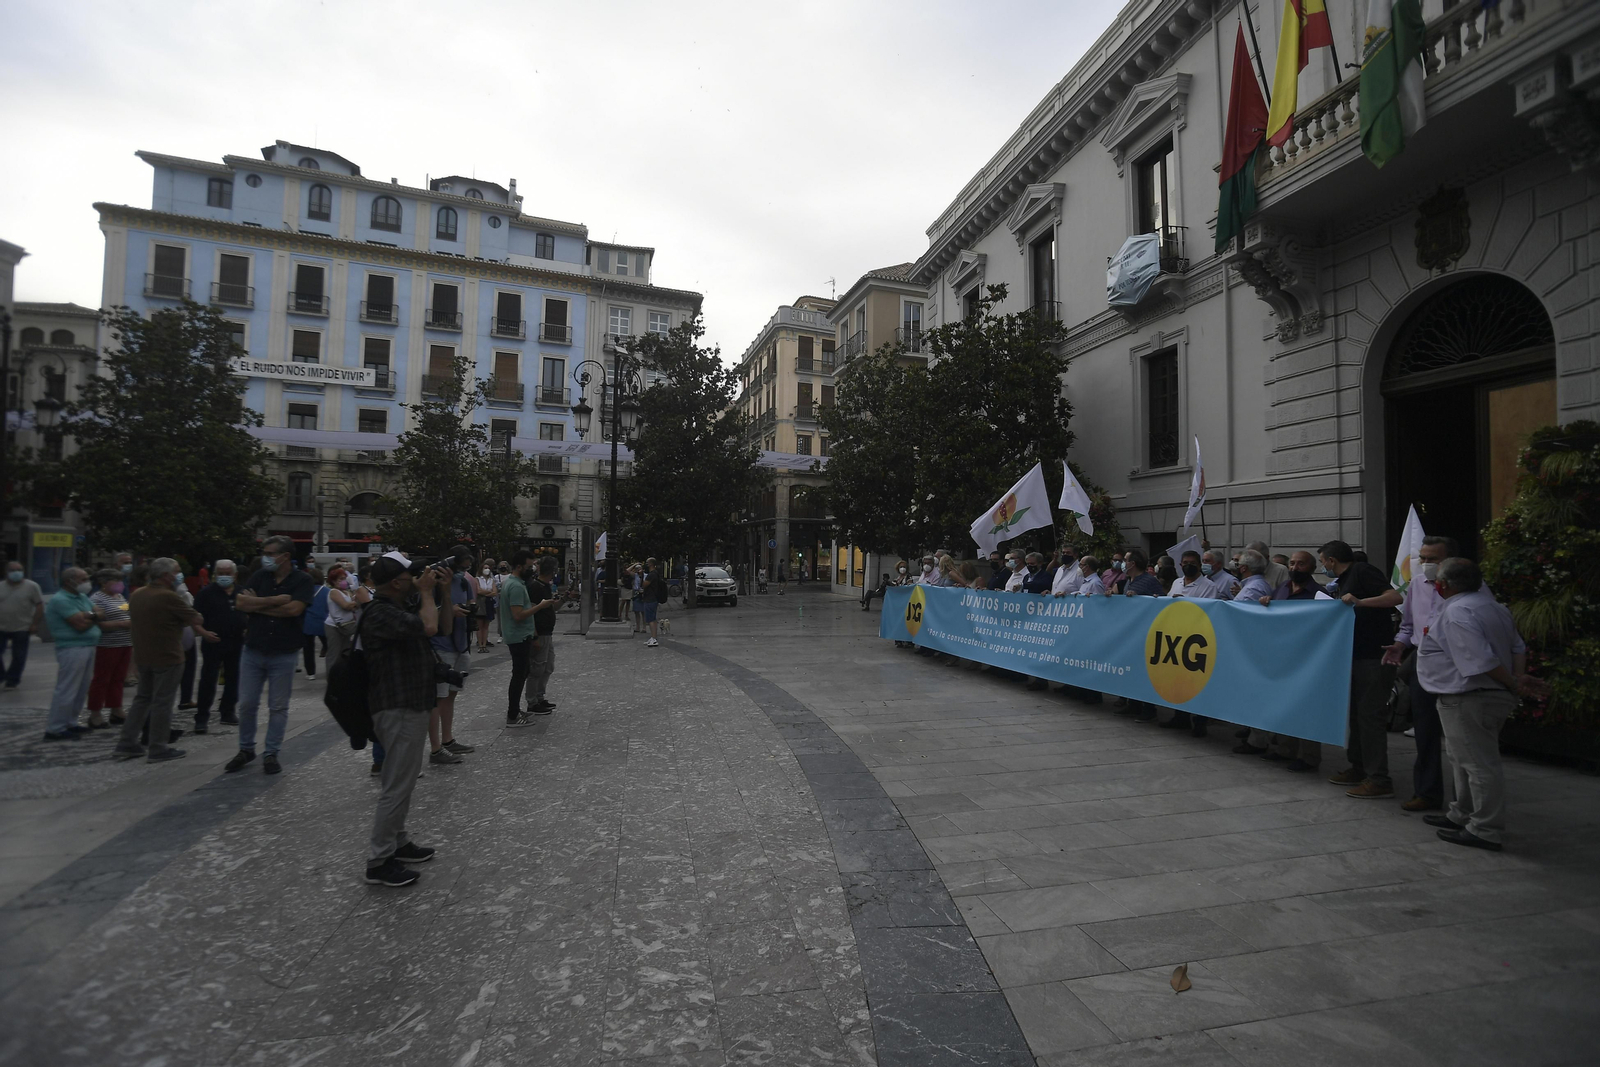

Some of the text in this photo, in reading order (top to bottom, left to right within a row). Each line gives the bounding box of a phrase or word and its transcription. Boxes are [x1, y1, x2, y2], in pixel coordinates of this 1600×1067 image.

[240, 361, 251, 372] EL
[254, 362, 284, 374] RUIDO
[286, 366, 306, 377] NOS
[308, 367, 340, 380] IMPIDE
[341, 370, 365, 382] VIVIR
[960, 594, 1084, 618] JUNTOS POR GRANADA
[966, 612, 1070, 635] GRANADA NO SE MERECE ESTO
[939, 630, 946, 639] la
[947, 634, 988, 649] convocatoria
[989, 643, 1015, 655] urgente
[1017, 647, 1026, 657] de
[1028, 650, 1038, 659] un
[1039, 652, 1060, 664] pleno
[994, 630, 1002, 638] YA
[1003, 631, 1011, 640] DE
[1012, 632, 1056, 647] DESGOBIERNO!
